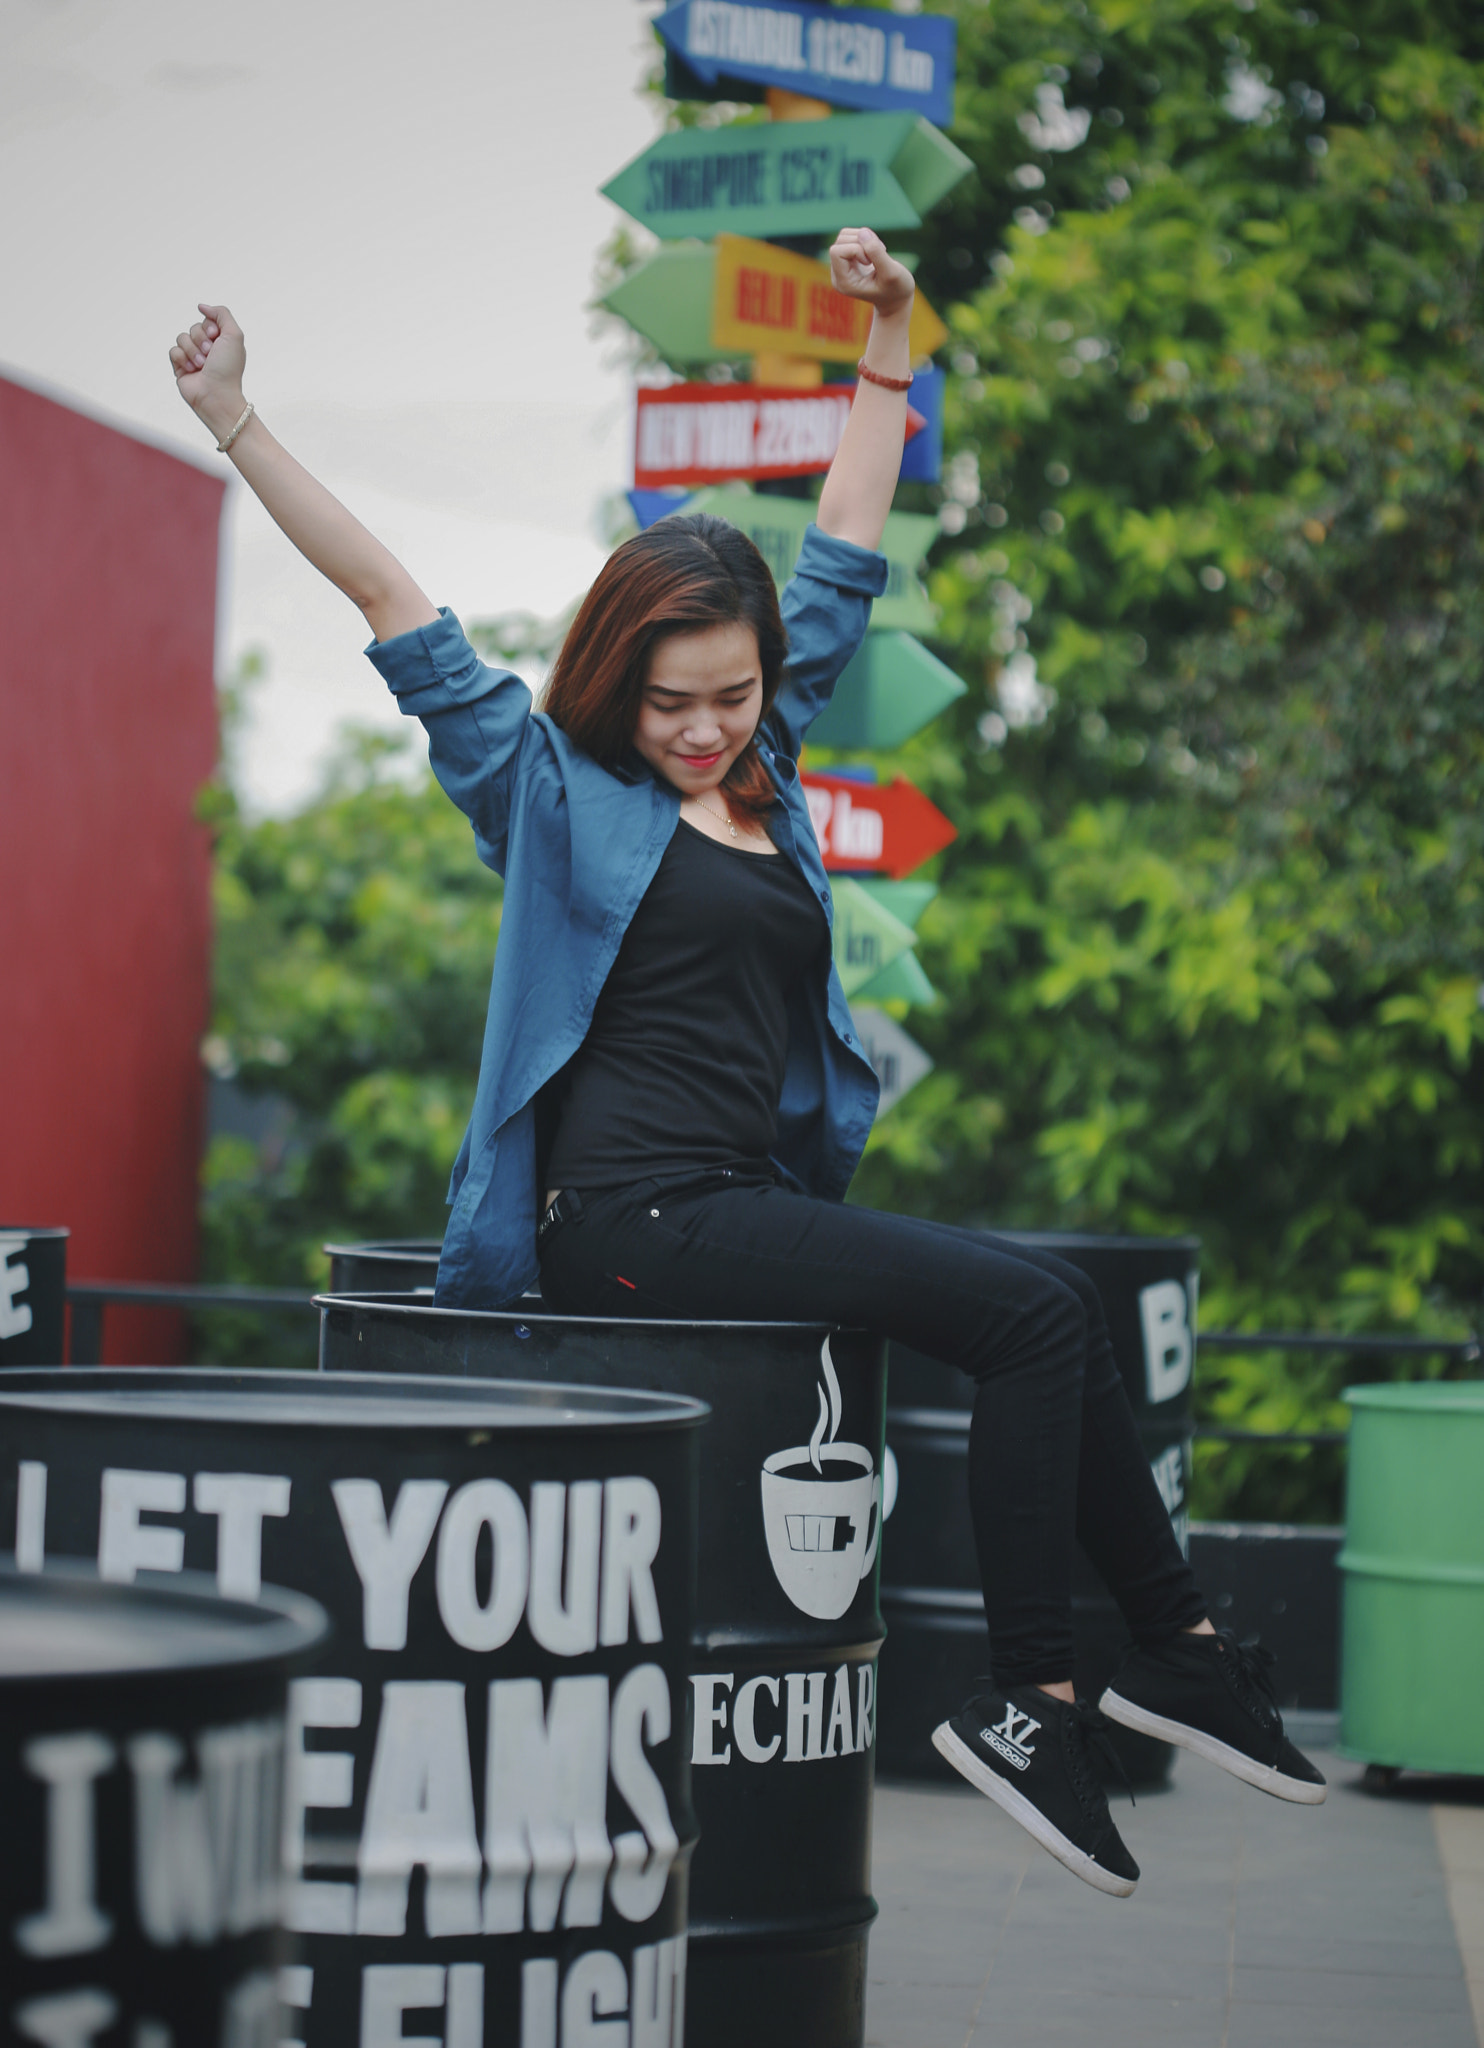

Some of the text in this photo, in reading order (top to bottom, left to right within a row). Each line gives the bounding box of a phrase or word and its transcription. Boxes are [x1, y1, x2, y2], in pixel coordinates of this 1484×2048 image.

[887, 32, 935, 92] km
[838, 144, 873, 198] km
[832, 789, 884, 860] km
[331, 1477, 662, 1656] YOUR
[992, 1702, 1042, 1755] XL
